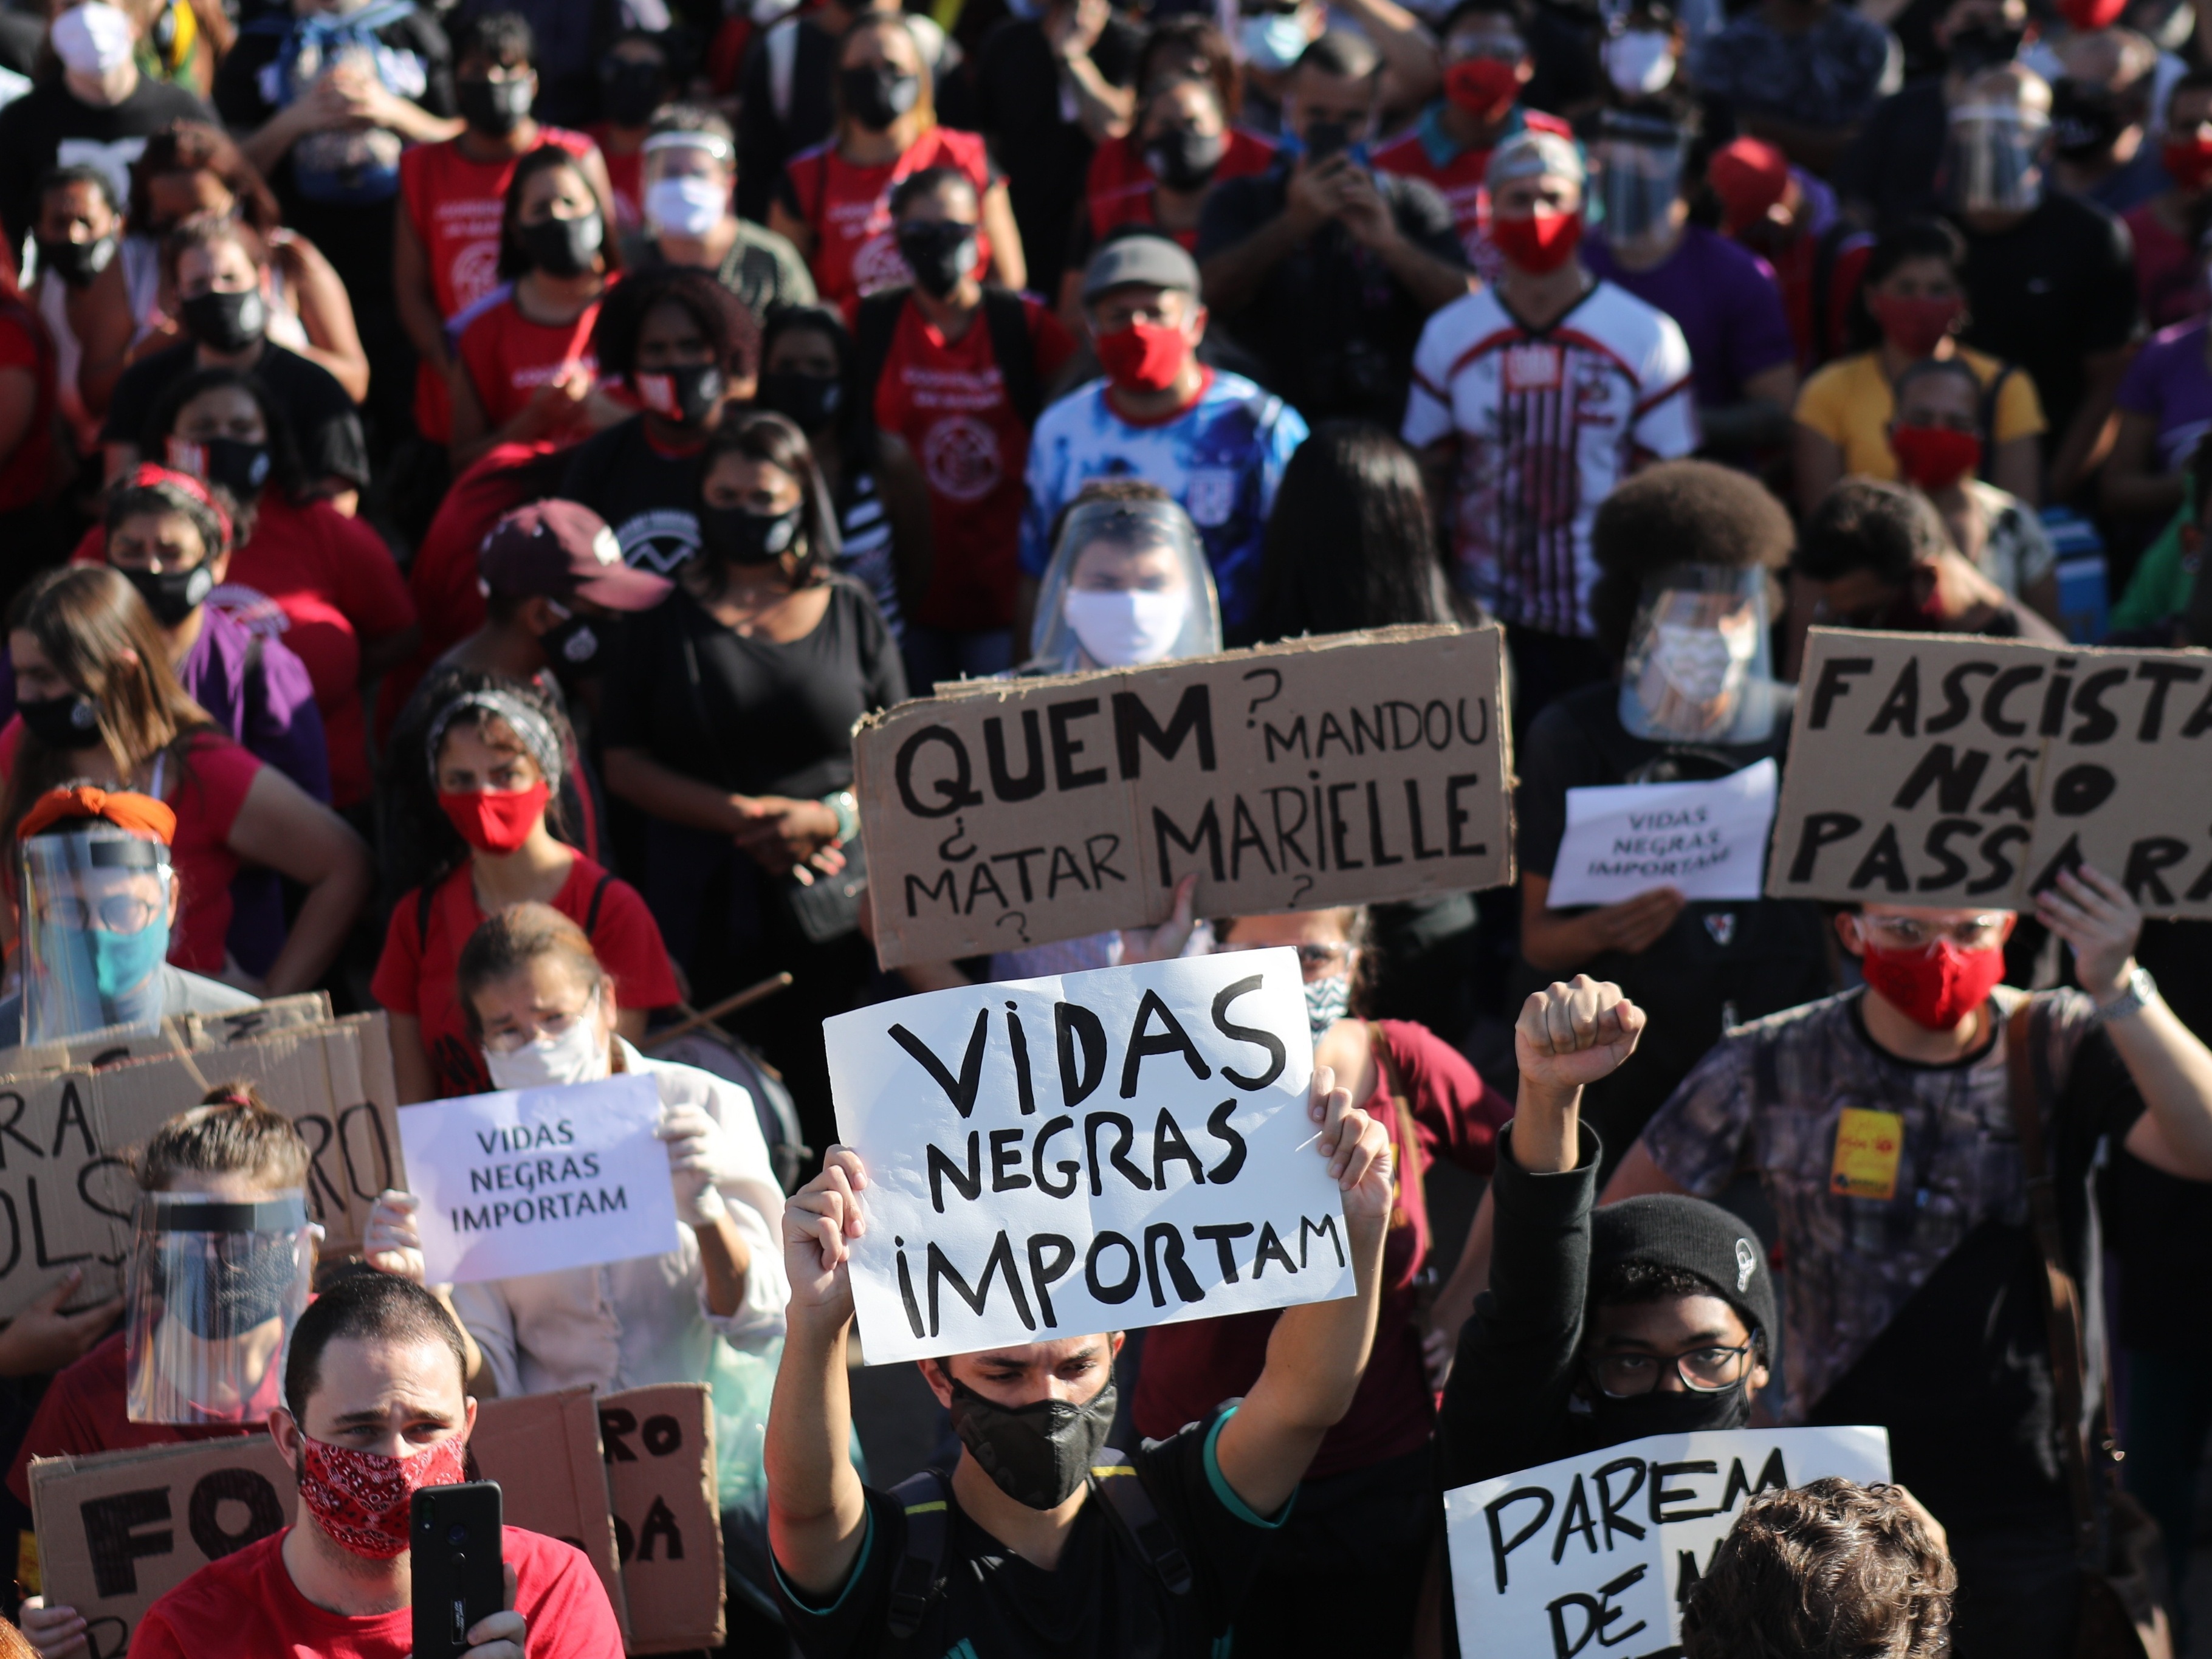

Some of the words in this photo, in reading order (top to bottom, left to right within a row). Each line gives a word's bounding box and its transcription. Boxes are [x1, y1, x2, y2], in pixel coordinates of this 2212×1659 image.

[895, 684, 1215, 819] QUEM
[1265, 698, 1488, 763] MANDOU
[1892, 743, 2116, 820] NÃO
[1613, 828, 1720, 856] NEGRAS
[1629, 806, 1709, 830] VIDAS
[905, 834, 1125, 918] MATAR
[1587, 847, 1729, 876] IMPORTAM
[476, 1119, 574, 1155] VIDAS
[926, 1097, 1247, 1213] NEGRAS
[470, 1153, 600, 1195] NEGRAS
[451, 1185, 628, 1233] IMPORTAM
[1484, 1446, 1788, 1593] PAREM
[1546, 1563, 1648, 1659] DE
